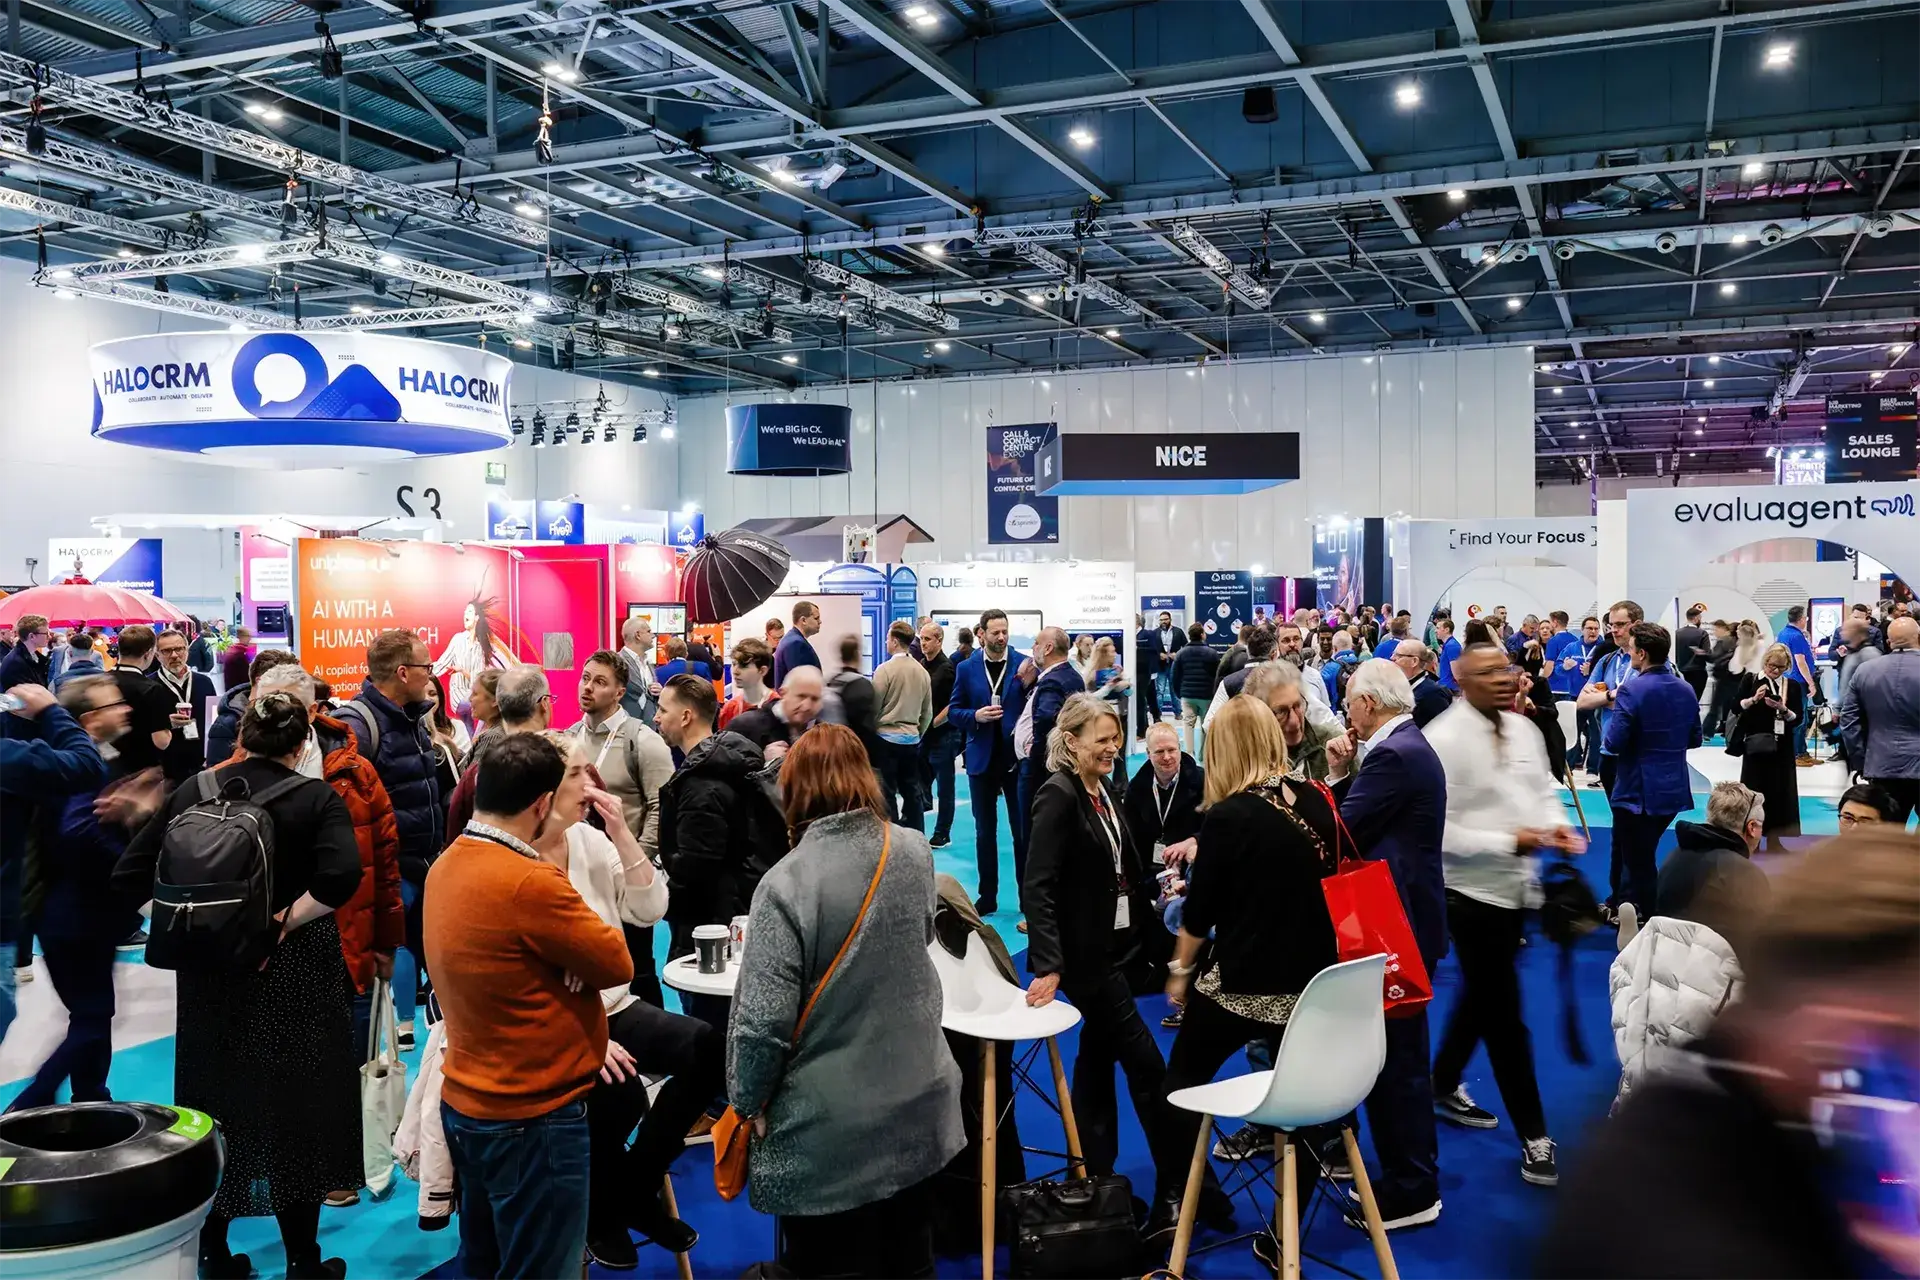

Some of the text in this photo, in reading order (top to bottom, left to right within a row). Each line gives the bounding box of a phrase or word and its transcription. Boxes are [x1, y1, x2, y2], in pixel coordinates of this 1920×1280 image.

[104, 362, 211, 395] HALOCRM
[398, 366, 501, 406] HALOCRM
[785, 425, 800, 433] BIG
[801, 425, 808, 433] in
[793, 437, 807, 445] We
[808, 437, 828, 446] LEAD
[828, 438, 834, 446] in
[1003, 436, 1041, 445] CONTACT
[1848, 434, 1894, 446] SALES
[1003, 443, 1033, 451] CENTRE
[1841, 446, 1901, 459] LOUNGE
[1003, 450, 1025, 458] EXPO
[1156, 446, 1207, 467] NICE
[1674, 495, 1867, 529] evaluagent
[1460, 531, 1586, 545] Find Your Focus
[1220, 573, 1236, 581] EGS
[312, 600, 394, 618] AI WITH A
[313, 628, 378, 649] HUMAN
[313, 662, 370, 678] AI copilot fo
